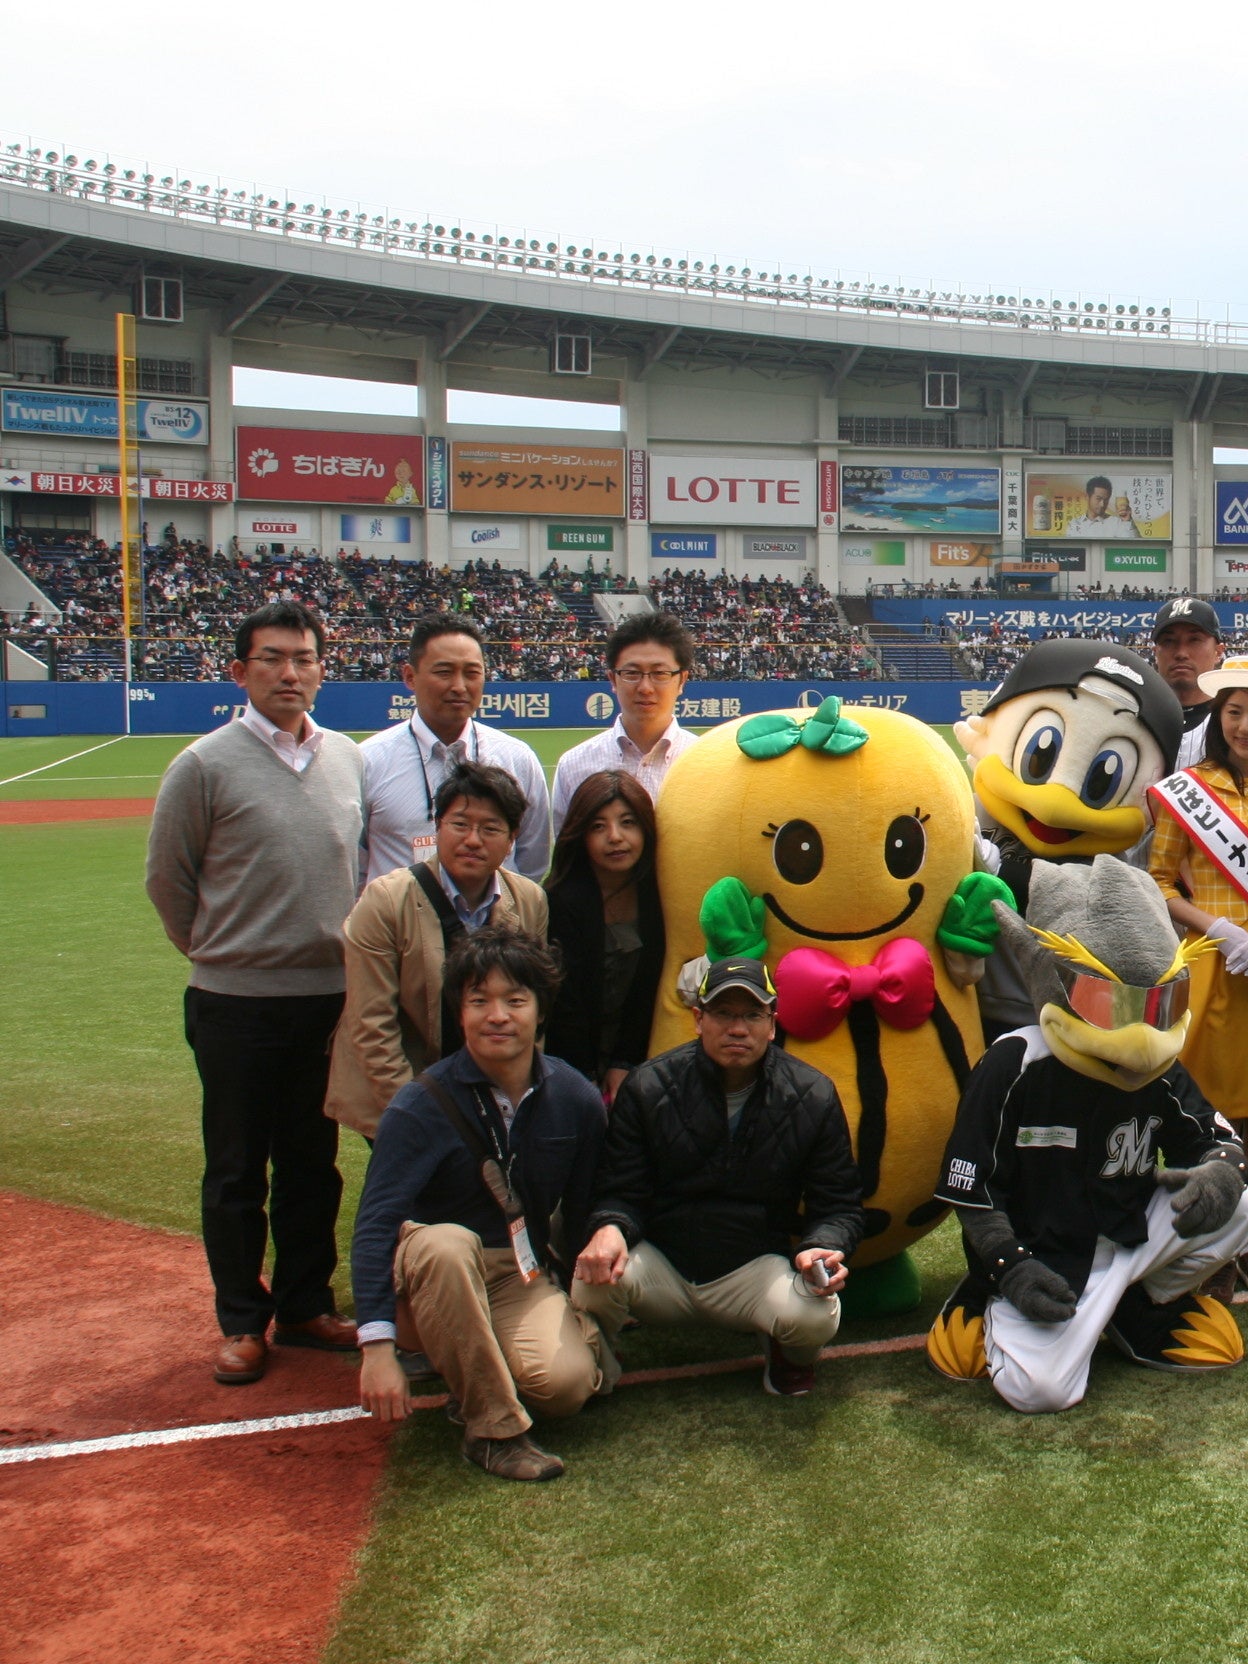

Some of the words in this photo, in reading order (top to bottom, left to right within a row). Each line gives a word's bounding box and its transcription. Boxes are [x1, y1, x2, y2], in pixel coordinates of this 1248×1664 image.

[6, 402, 88, 424] TwellV
[175, 406, 191, 418] 12
[150, 416, 190, 428] TwellV
[292, 455, 385, 478] ちばぎん
[37, 474, 115, 494] 朝日火災
[155, 480, 228, 500] 朝日火災
[458, 470, 618, 493] サンダンス・リゾート
[632, 450, 644, 520] 城西国際大学
[667, 476, 800, 504] LOTTE
[1008, 483, 1018, 531] 千葉商大
[255, 524, 294, 533] LOTTE
[472, 528, 500, 544] Coolish
[586, 533, 606, 544] GUM
[687, 540, 709, 551] MINT
[937, 544, 970, 561] Fit's
[1122, 555, 1158, 565] XYLITOL
[946, 610, 1157, 628] マリーンズ戦をハイビジョンで
[473, 693, 550, 718] 면세점
[839, 694, 908, 710] ッテリア
[388, 708, 413, 721] 免税
[1100, 1116, 1163, 1178] M
[950, 1157, 977, 1177] CHIBA
[947, 1172, 976, 1190] LOTTE
